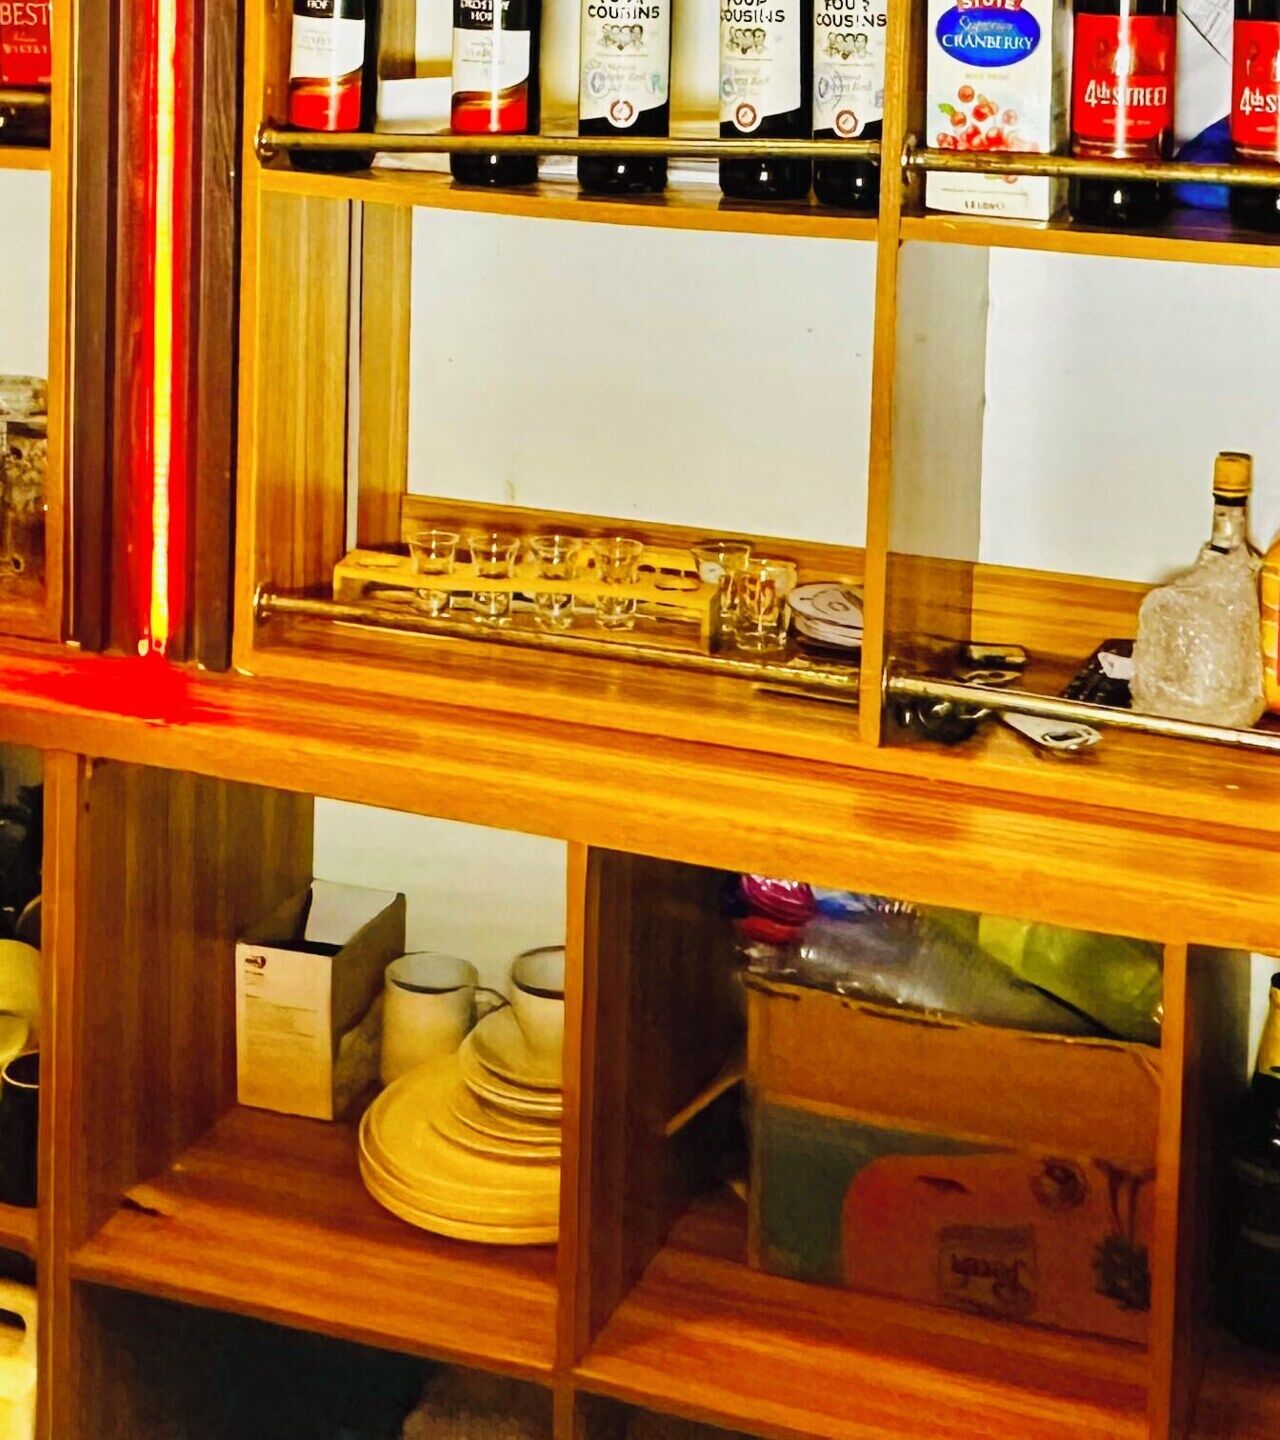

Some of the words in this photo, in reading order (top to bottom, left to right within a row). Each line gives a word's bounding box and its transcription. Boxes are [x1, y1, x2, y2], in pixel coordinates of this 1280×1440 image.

[0, 2, 48, 26] BEST
[588, 5, 660, 20] COUSINS
[942, 33, 1034, 50] CRANBERRY
